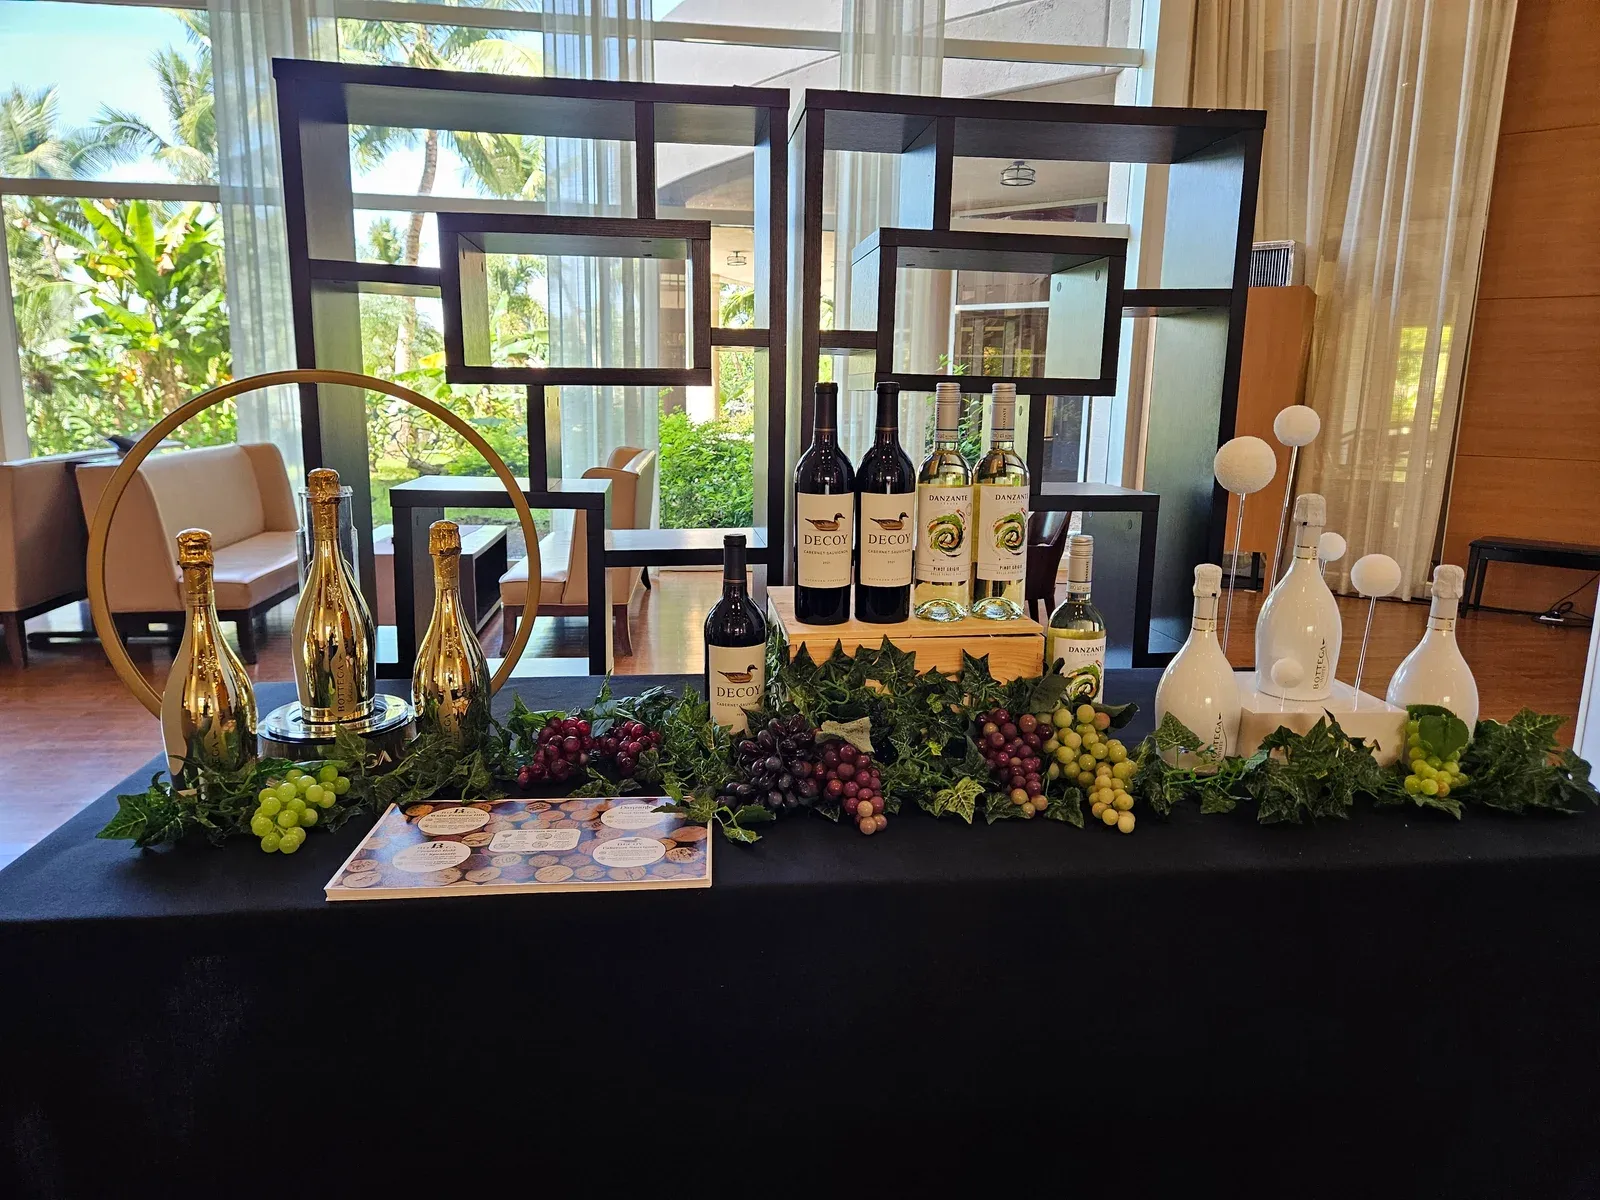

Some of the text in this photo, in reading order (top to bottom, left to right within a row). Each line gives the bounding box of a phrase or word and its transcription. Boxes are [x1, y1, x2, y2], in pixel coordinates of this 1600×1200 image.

[929, 494, 968, 502] DANZANTE
[803, 534, 849, 546] DECOY
[868, 533, 911, 546] DECOY
[1312, 645, 1326, 690] BOTTEGA
[337, 664, 346, 712] BOTTEGA
[716, 684, 761, 698] DECOY
[1211, 720, 1223, 761] OTTEGA
